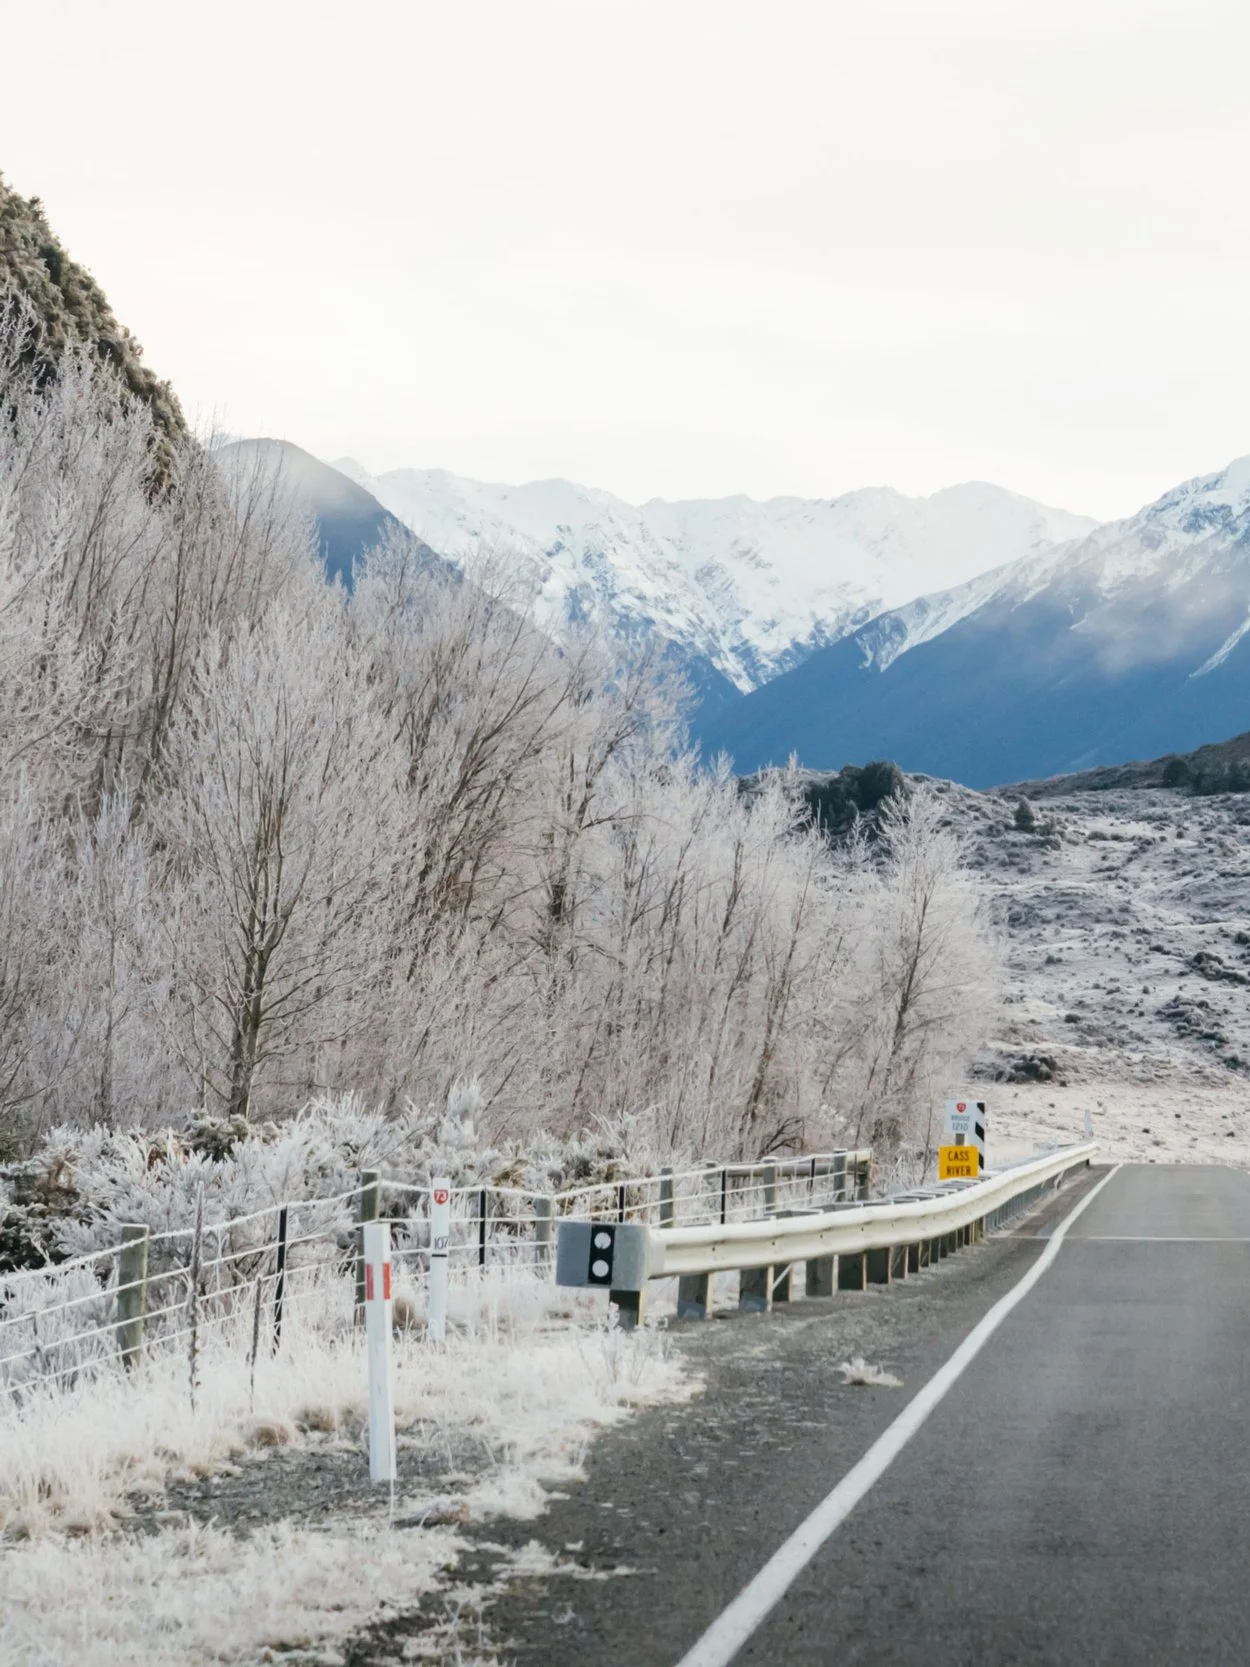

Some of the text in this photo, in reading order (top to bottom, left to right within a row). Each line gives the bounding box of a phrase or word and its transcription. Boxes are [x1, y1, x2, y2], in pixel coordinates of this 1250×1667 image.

[948, 1150, 970, 1161] CASS
[946, 1165, 971, 1176] RIVER
[435, 1191, 447, 1201] 73
[434, 1237, 448, 1249] 107
